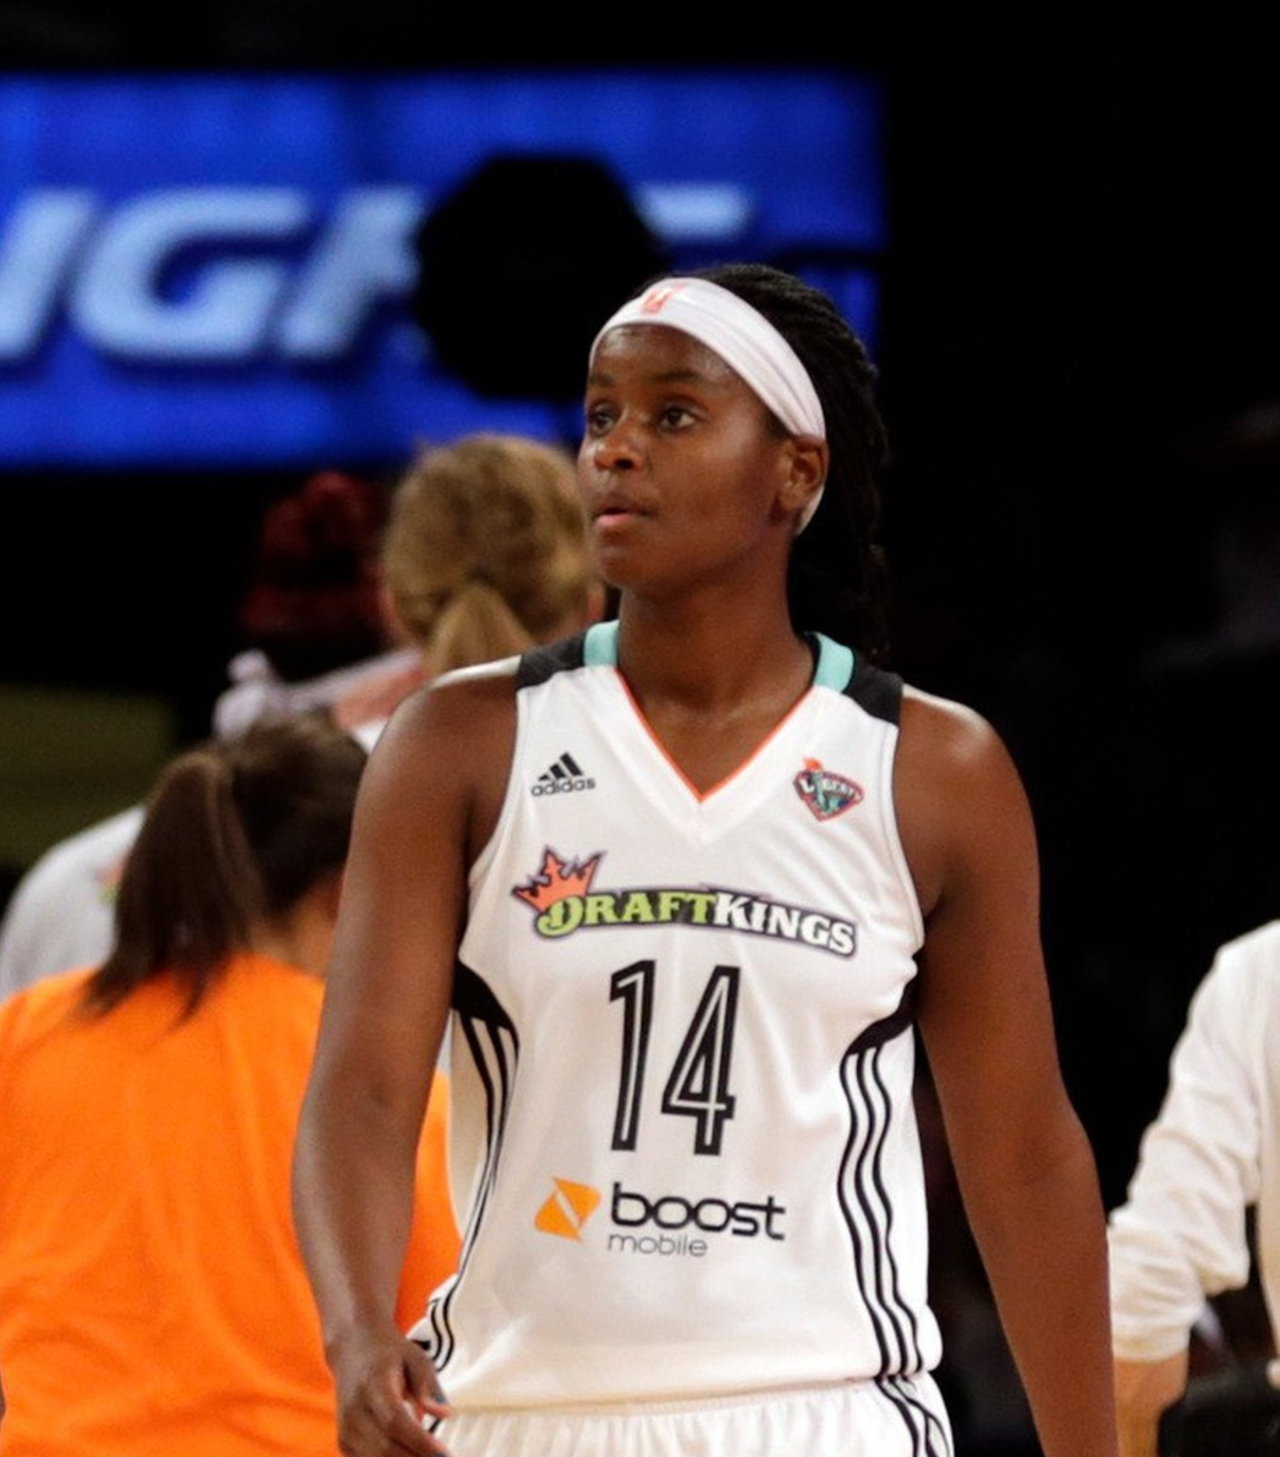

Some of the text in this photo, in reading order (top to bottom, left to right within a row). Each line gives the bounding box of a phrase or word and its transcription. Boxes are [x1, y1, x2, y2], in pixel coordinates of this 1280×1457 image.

[531, 776, 596, 797] adidas
[537, 888, 856, 956] DRAFTKINGS
[608, 959, 742, 1156] 14
[612, 1182, 786, 1240] boost
[608, 1233, 708, 1257] mobile
